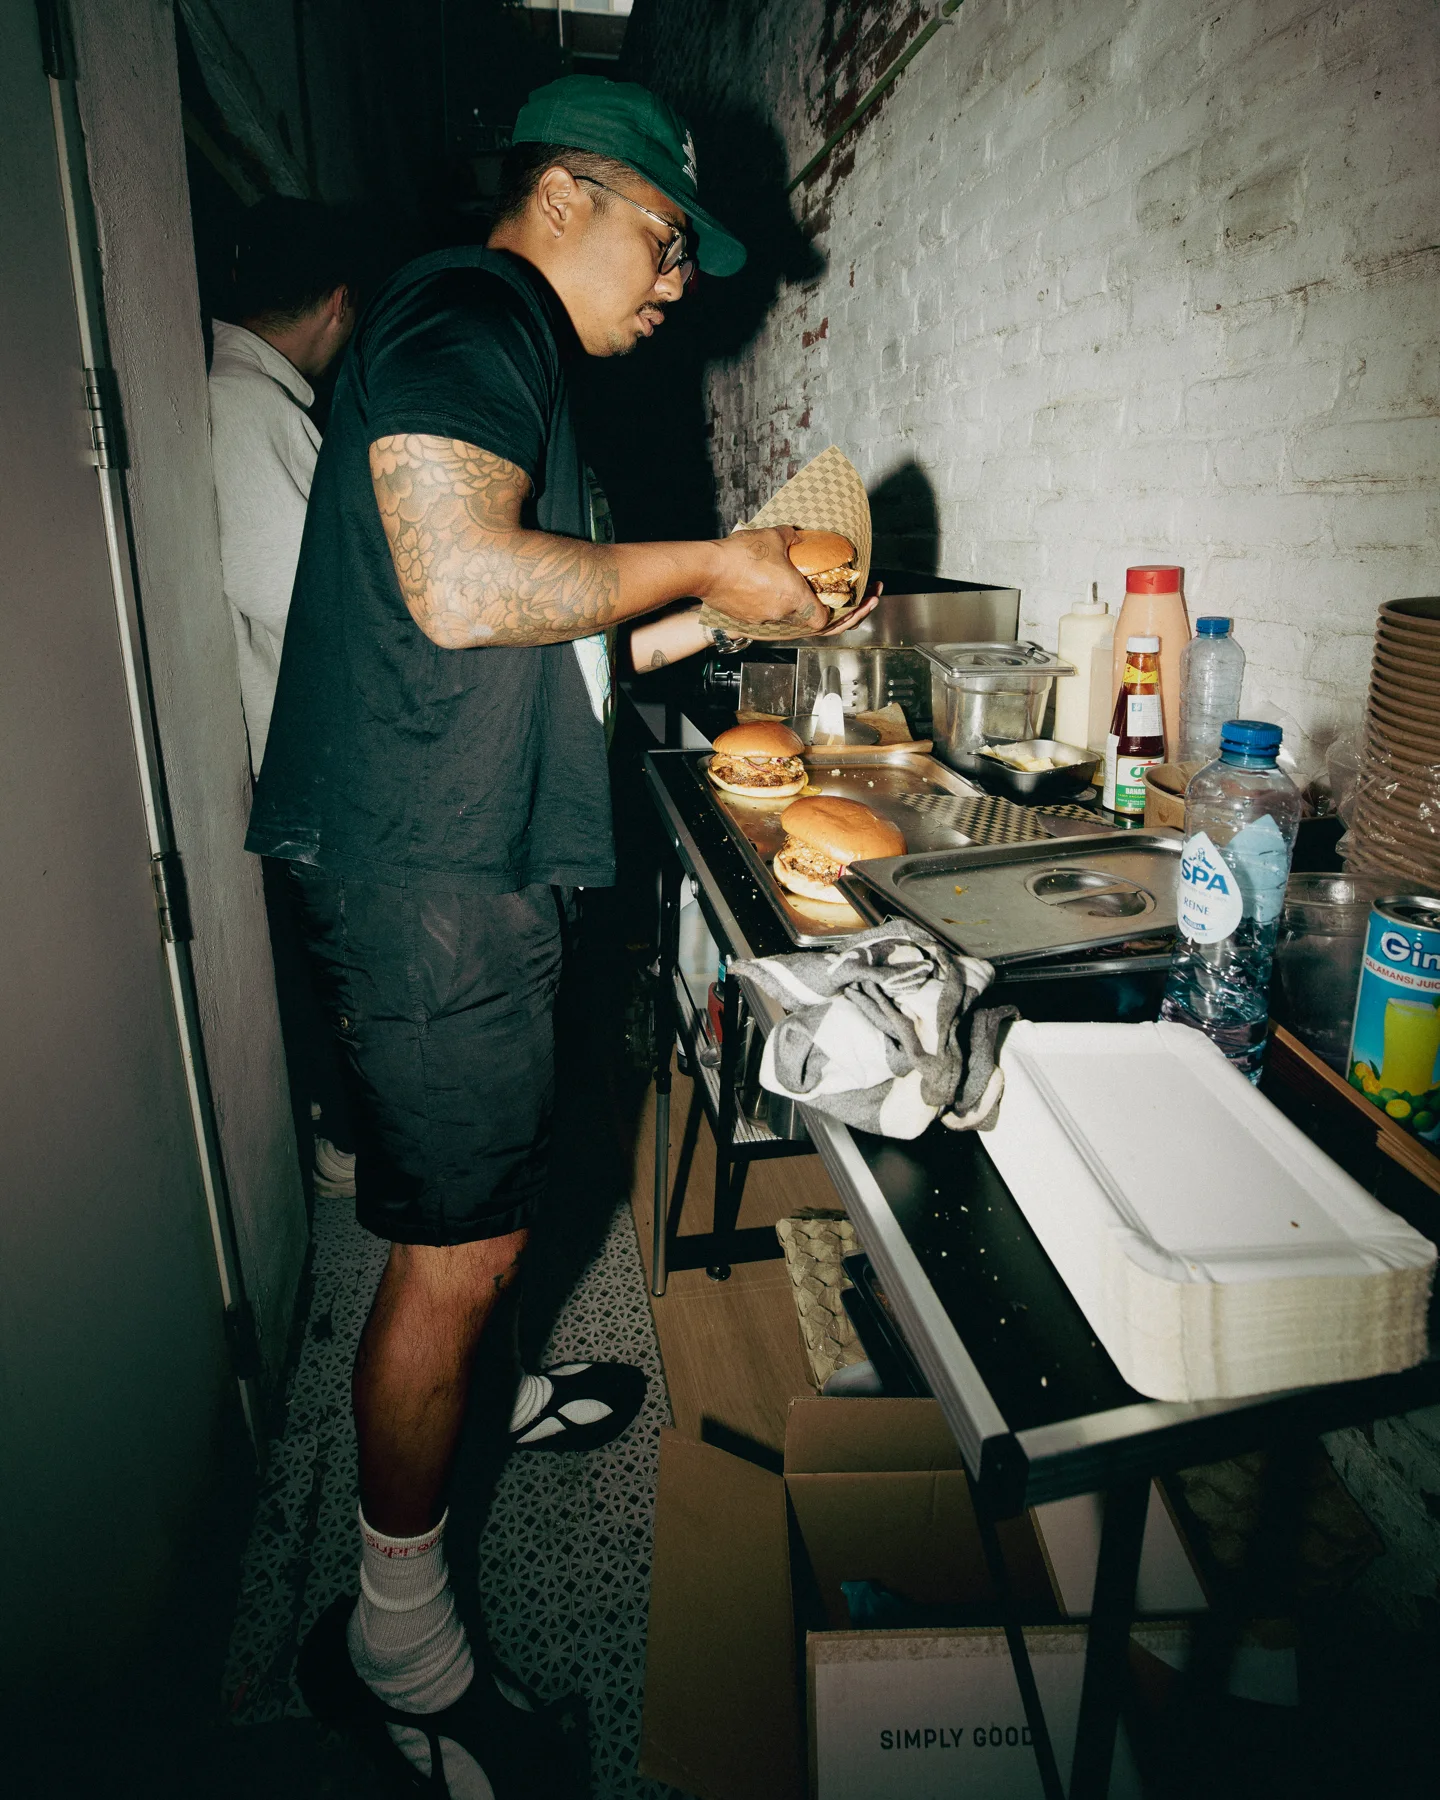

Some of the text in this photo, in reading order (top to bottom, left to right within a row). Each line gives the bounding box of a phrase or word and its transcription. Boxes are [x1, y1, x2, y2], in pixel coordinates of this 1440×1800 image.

[1181, 858, 1230, 896] SPA
[1183, 896, 1210, 916] REINE
[1365, 957, 1415, 985] CALAMANSI
[880, 1726, 1034, 1750] SIMPLY GOOD
